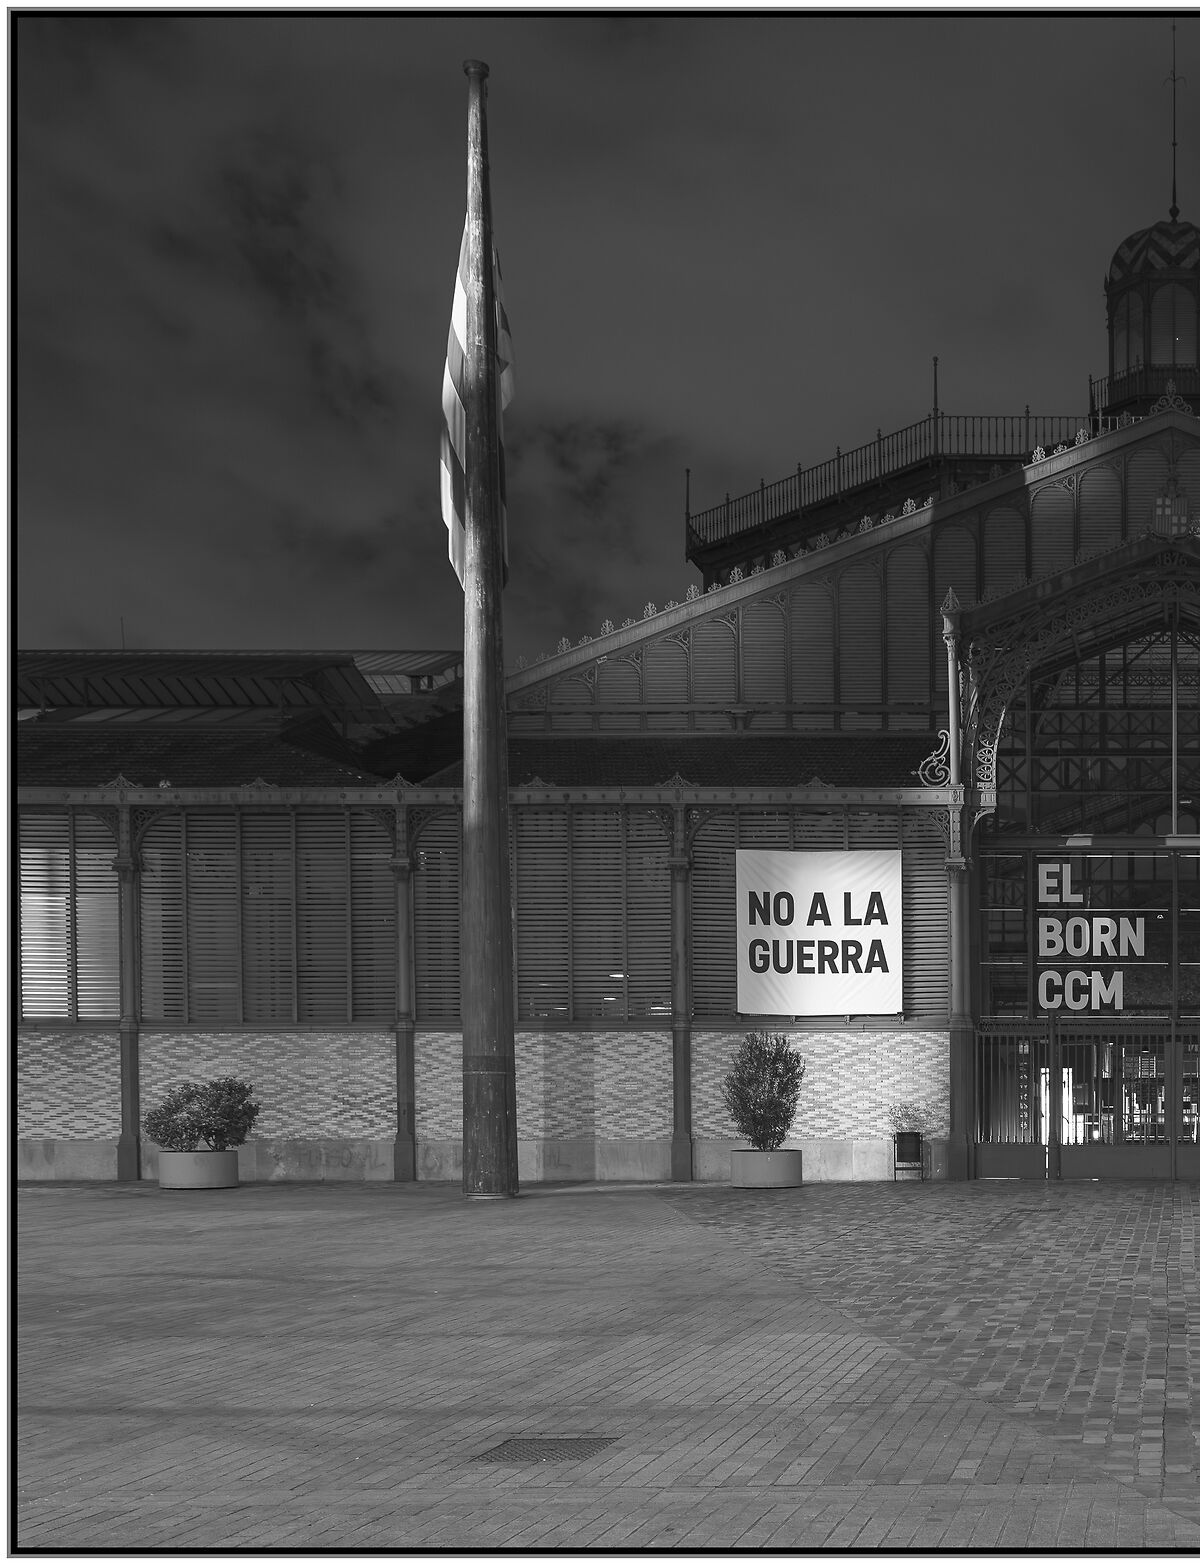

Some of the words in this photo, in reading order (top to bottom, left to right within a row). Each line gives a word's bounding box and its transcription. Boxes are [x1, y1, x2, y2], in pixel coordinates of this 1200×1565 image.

[1038, 863, 1084, 903] EL
[748, 891, 795, 926] NO
[806, 892, 832, 926] A
[843, 892, 889, 926] LA
[748, 938, 890, 975] GUERRA
[1038, 917, 1145, 957] BORN
[1038, 970, 1124, 1011] CCM
